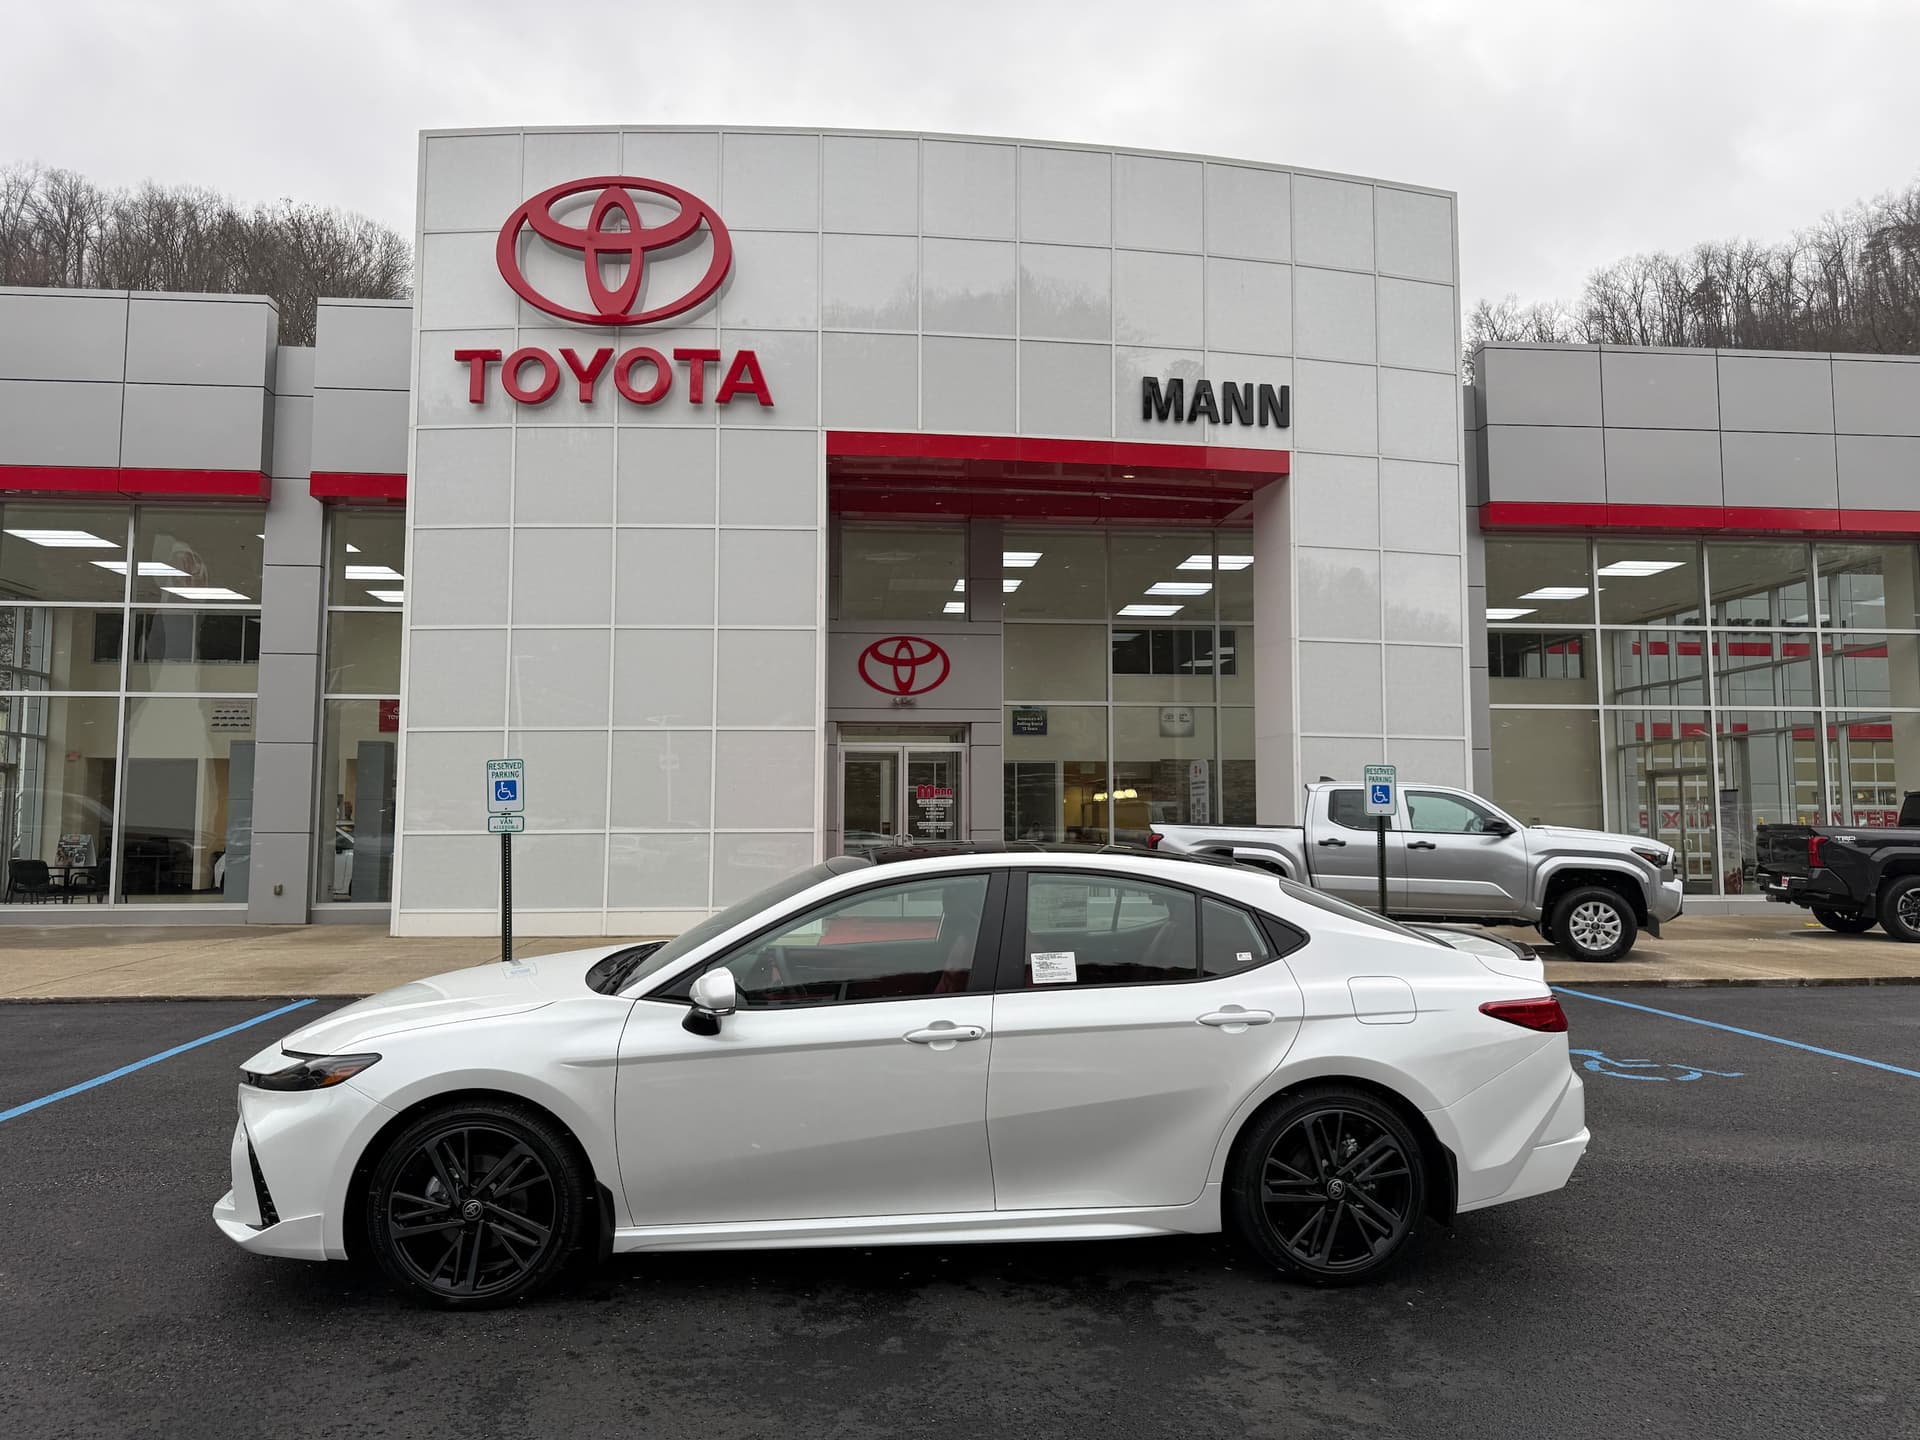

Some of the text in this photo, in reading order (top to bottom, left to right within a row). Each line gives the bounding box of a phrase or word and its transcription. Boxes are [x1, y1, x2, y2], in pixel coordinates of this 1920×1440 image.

[454, 347, 775, 407] TOYOTA
[1142, 376, 1290, 428] MANN
[488, 762, 522, 770] RESERVED
[491, 771, 520, 779] PARKING
